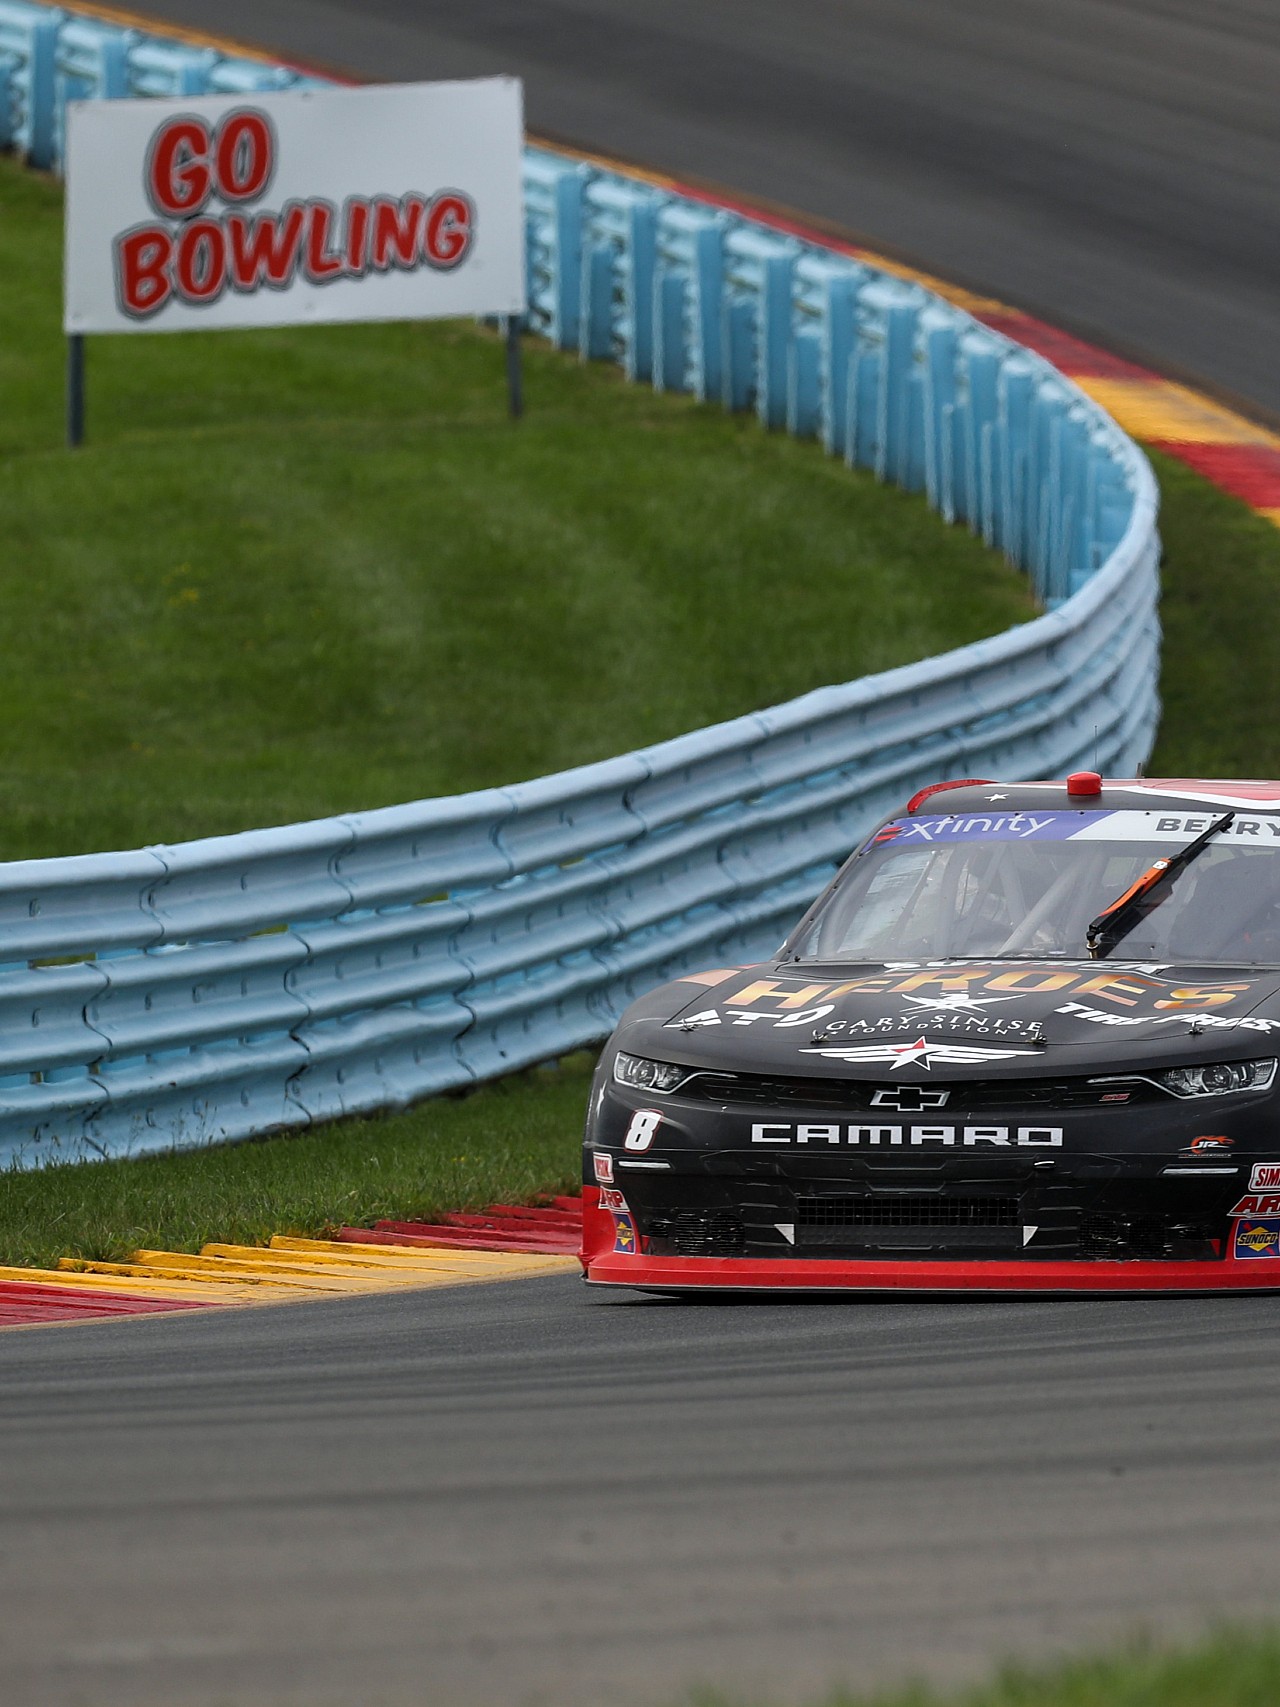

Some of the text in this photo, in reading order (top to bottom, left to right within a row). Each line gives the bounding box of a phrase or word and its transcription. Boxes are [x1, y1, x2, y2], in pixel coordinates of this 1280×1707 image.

[149, 110, 273, 214] GO
[119, 196, 470, 314] BOWLING
[904, 814, 1056, 840] xfinity
[722, 970, 1250, 1010] HEROES
[662, 1004, 836, 1028] ATD
[825, 1014, 1044, 1032] GARY SINISE
[1053, 1002, 1160, 1026] TIRE
[848, 1023, 1009, 1036] FOUNDATION
[624, 1110, 662, 1151] 8
[751, 1124, 1063, 1146] CAMARO
[1239, 1233, 1277, 1245] SUNOCO
